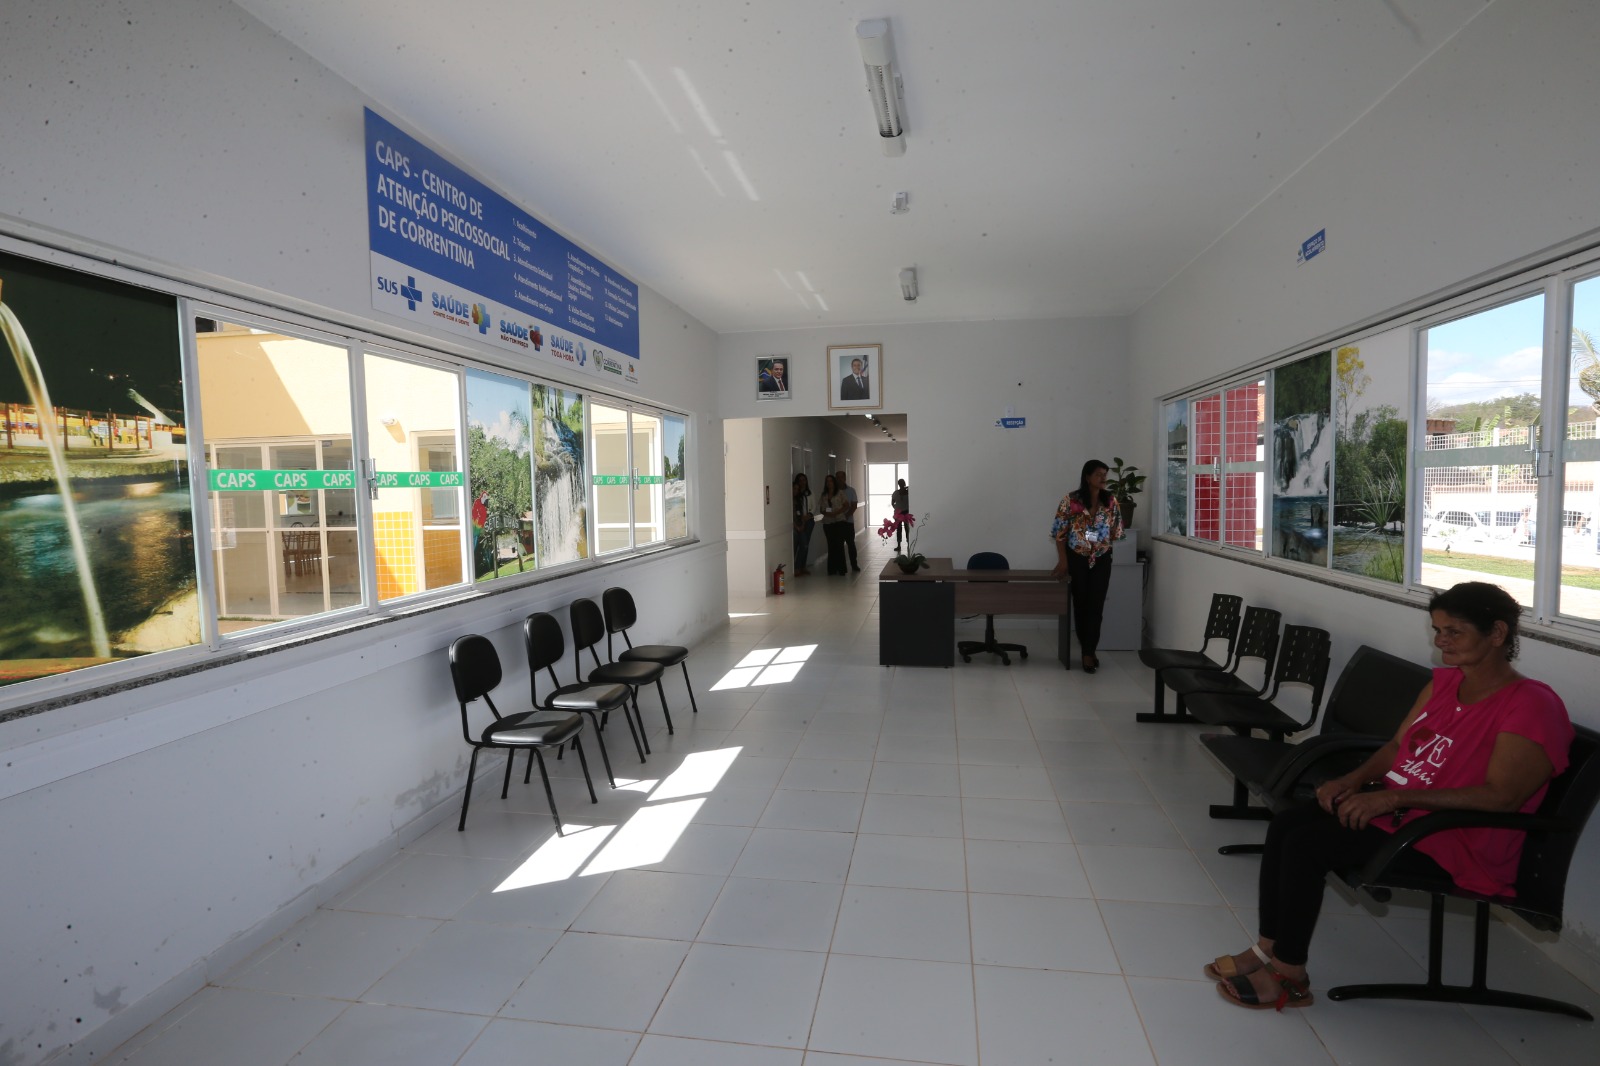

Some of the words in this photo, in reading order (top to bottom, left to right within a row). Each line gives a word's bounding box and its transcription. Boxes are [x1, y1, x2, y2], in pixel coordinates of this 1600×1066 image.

[376, 140, 410, 178] CAPS
[422, 169, 467, 211] CENTRO
[470, 196, 483, 220] DE
[377, 173, 438, 222] ATENÇÃO
[441, 208, 510, 262] PSICOSSOCIAL
[378, 205, 397, 234] DE
[400, 217, 475, 270] CORRENTINA
[377, 276, 398, 296] SUS
[432, 291, 469, 318] SAÚDE
[500, 320, 528, 340] SAÚDE
[551, 334, 573, 353] SAÚDE
[217, 472, 256, 488] CAPS
[274, 473, 308, 487] CAPS
[322, 473, 352, 486] CAPS
[409, 474, 430, 486] CAPS
[440, 474, 459, 485] CAPS
